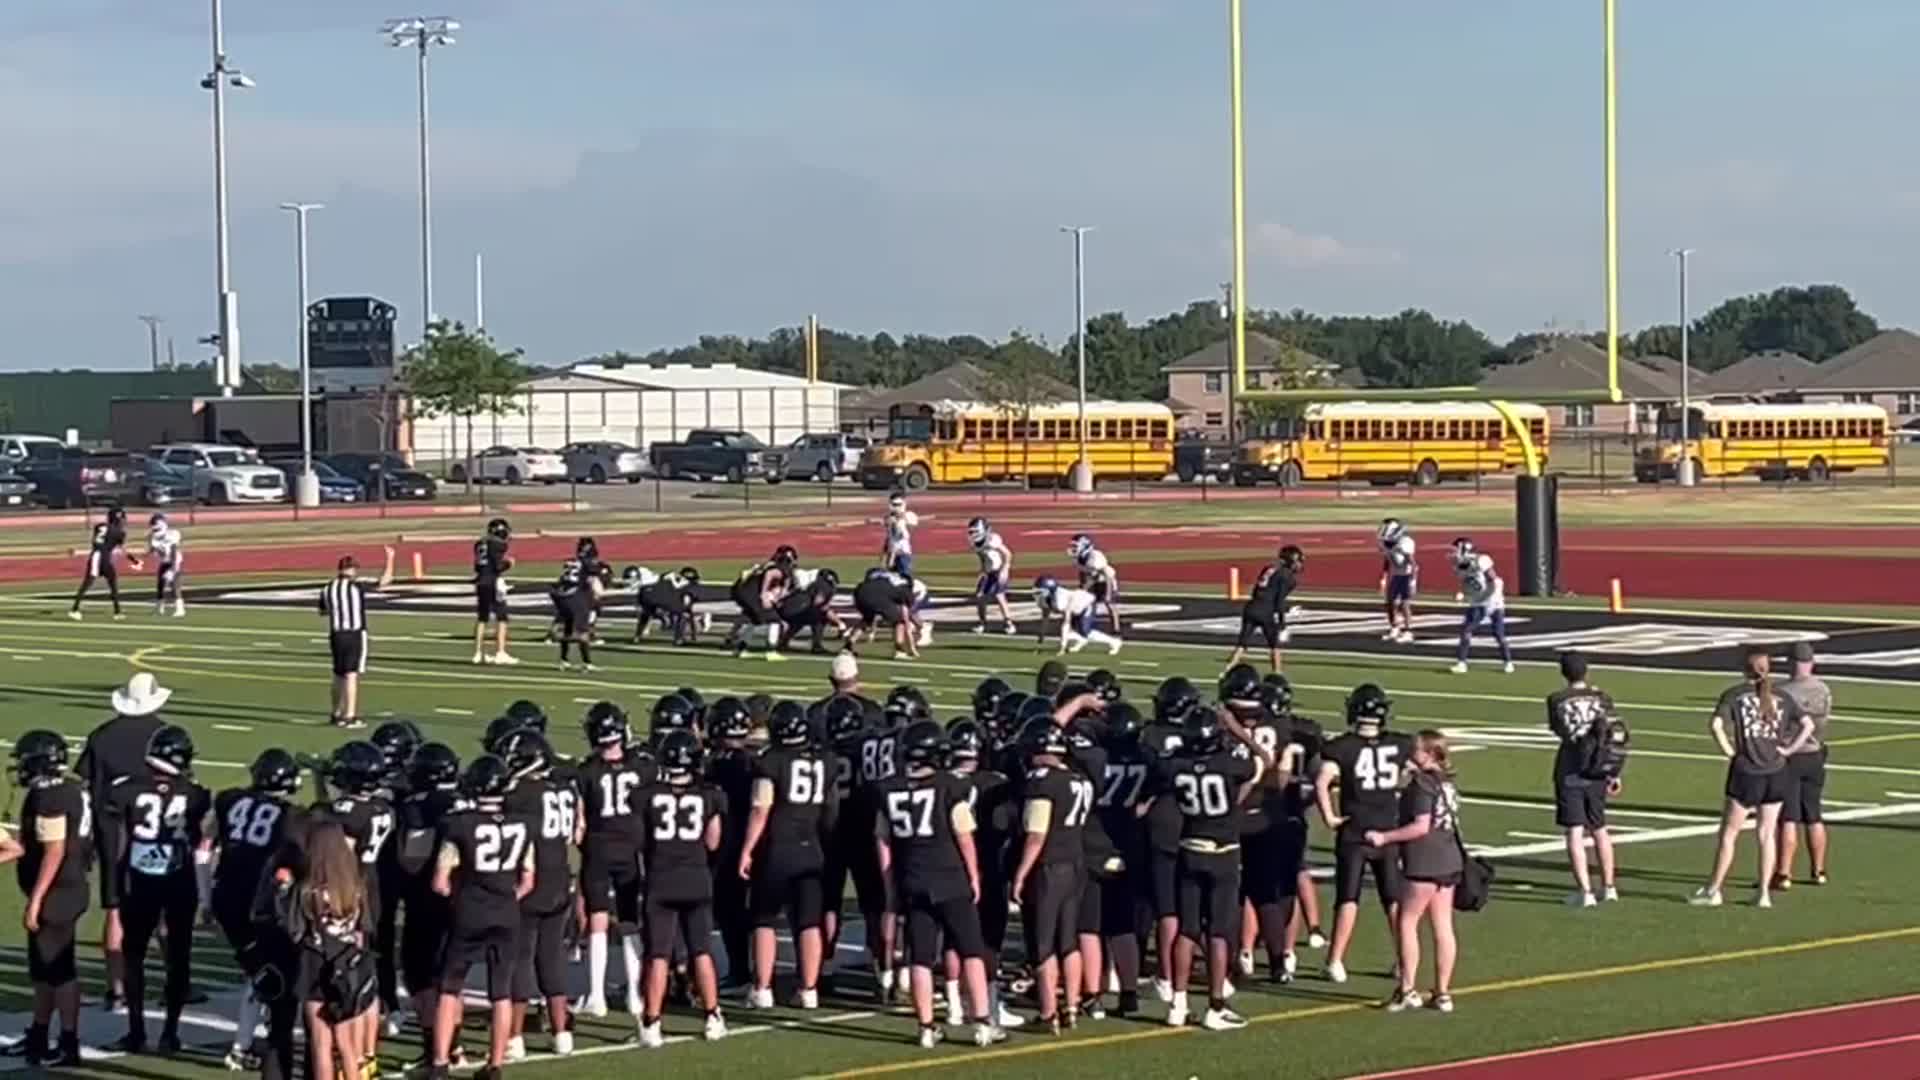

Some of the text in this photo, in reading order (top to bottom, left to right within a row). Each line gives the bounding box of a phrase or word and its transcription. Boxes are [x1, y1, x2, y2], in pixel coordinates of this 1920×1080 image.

[789, 759, 825, 804] 61
[862, 737, 897, 781] 88
[1354, 745, 1399, 790] 45
[1098, 764, 1148, 806] 77
[1174, 773, 1229, 816] 30
[133, 792, 188, 840] 34
[227, 796, 282, 847] 48
[542, 789, 575, 839] 66
[652, 793, 705, 841] 33
[887, 788, 936, 838] 57
[475, 822, 527, 872] 27
